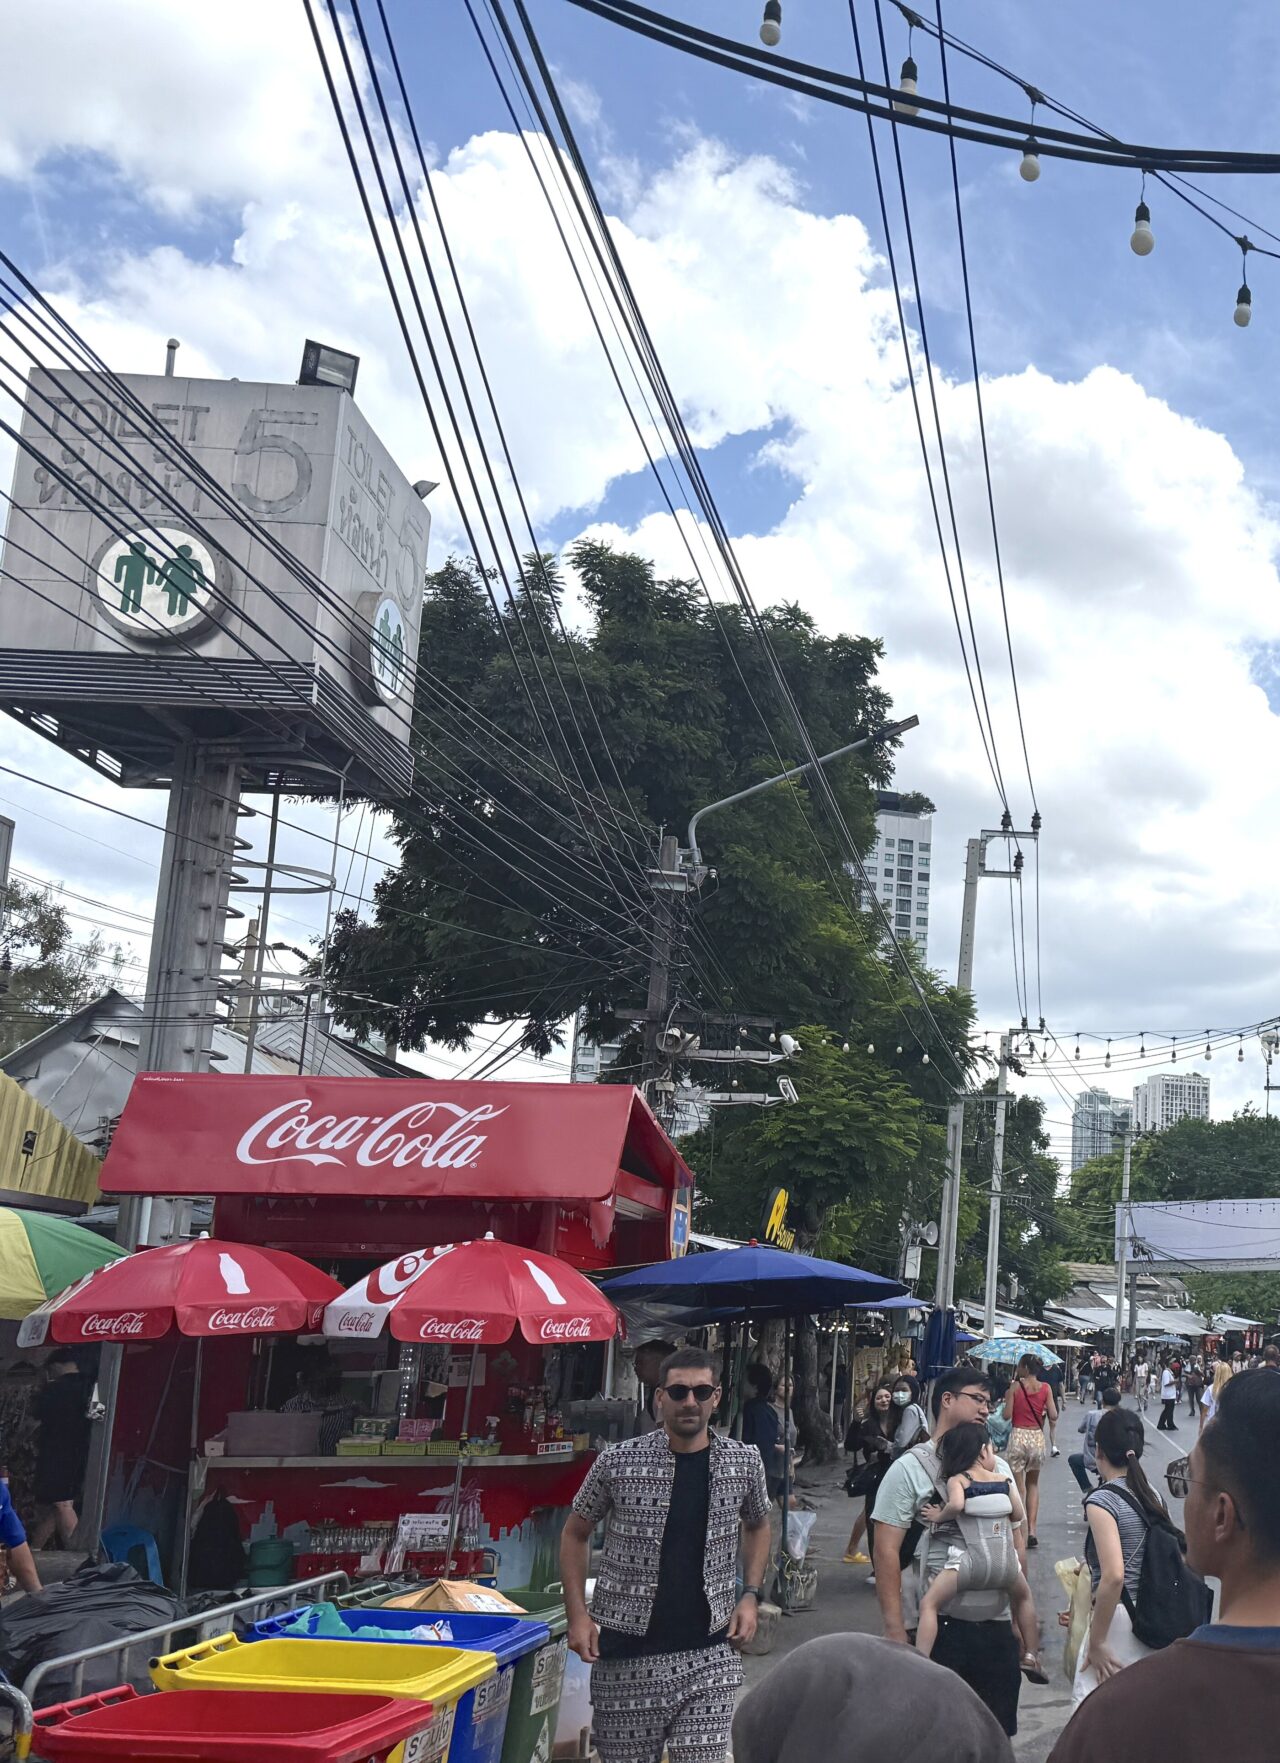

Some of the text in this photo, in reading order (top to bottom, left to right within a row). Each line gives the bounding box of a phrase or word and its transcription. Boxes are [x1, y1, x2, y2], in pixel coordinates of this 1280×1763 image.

[47, 396, 211, 441] TOILET
[232, 408, 319, 515] 5
[347, 424, 396, 519] TOILET
[236, 1099, 511, 1169] Coca-Cola
[81, 1312, 149, 1336] Coca-Cola
[208, 1306, 280, 1330] Coca-Cola
[338, 1311, 377, 1332] Coca-Cola
[420, 1317, 489, 1340] Coca-Cola
[540, 1317, 592, 1339] Coca-Cola
